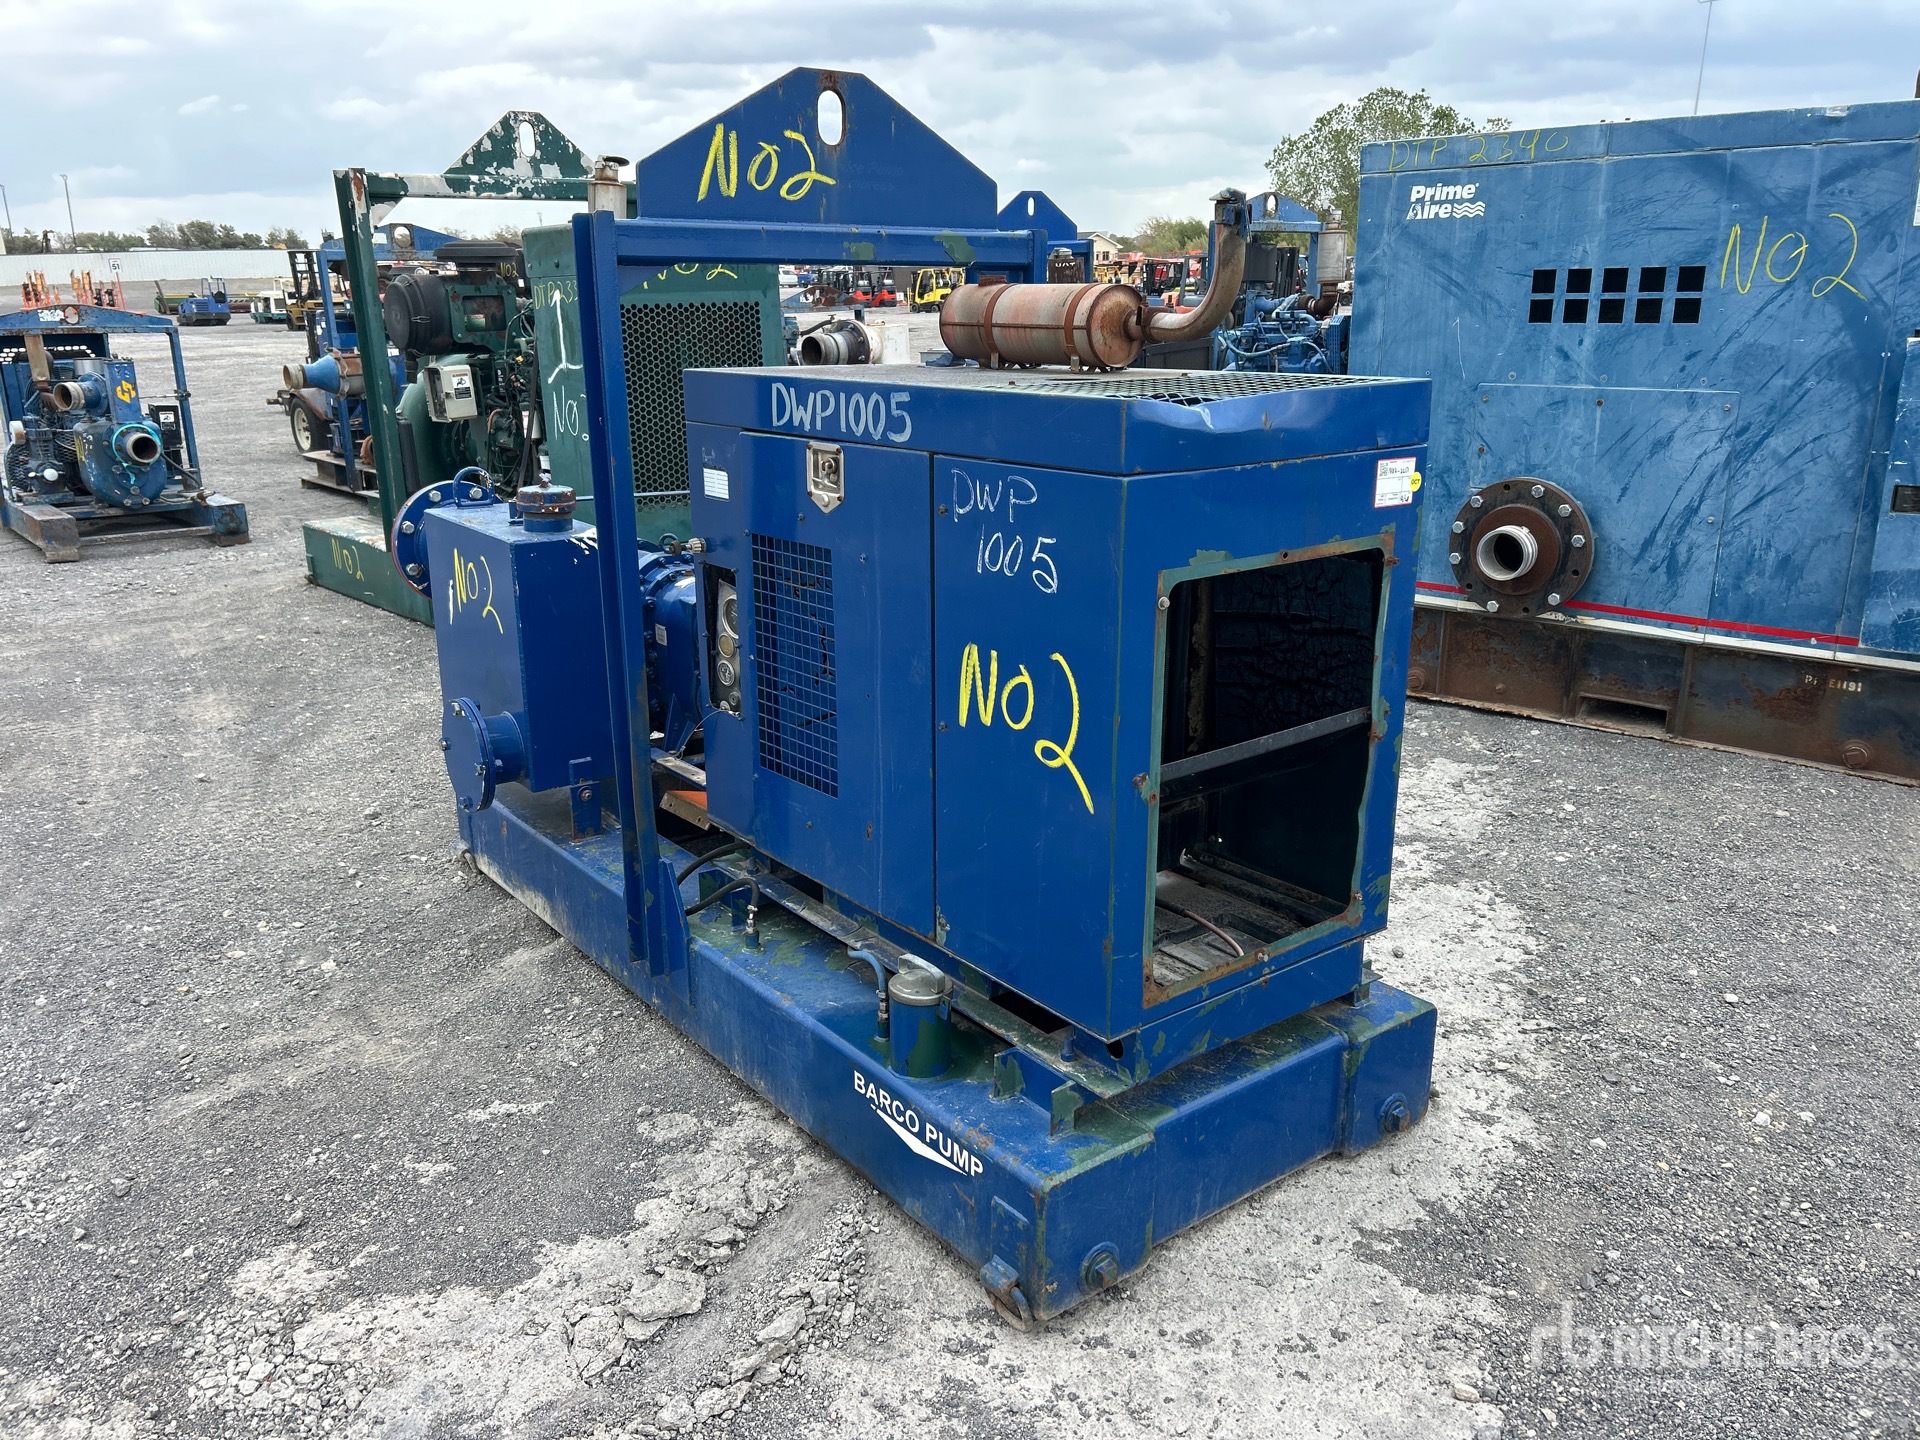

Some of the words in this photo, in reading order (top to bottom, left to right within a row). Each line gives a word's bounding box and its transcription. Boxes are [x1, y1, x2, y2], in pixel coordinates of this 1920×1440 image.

[1390, 137, 1448, 171] DTP
[1467, 130, 1569, 162] 2340
[1406, 202, 1452, 219] Aire
[1410, 182, 1475, 202] Prime
[111, 263, 120, 271] 51
[771, 382, 913, 443] DWP1005
[950, 468, 1038, 523] DWP
[976, 523, 1059, 594] 1005
[853, 1070, 921, 1133] BARCO
[925, 1122, 984, 1177] PUMP
